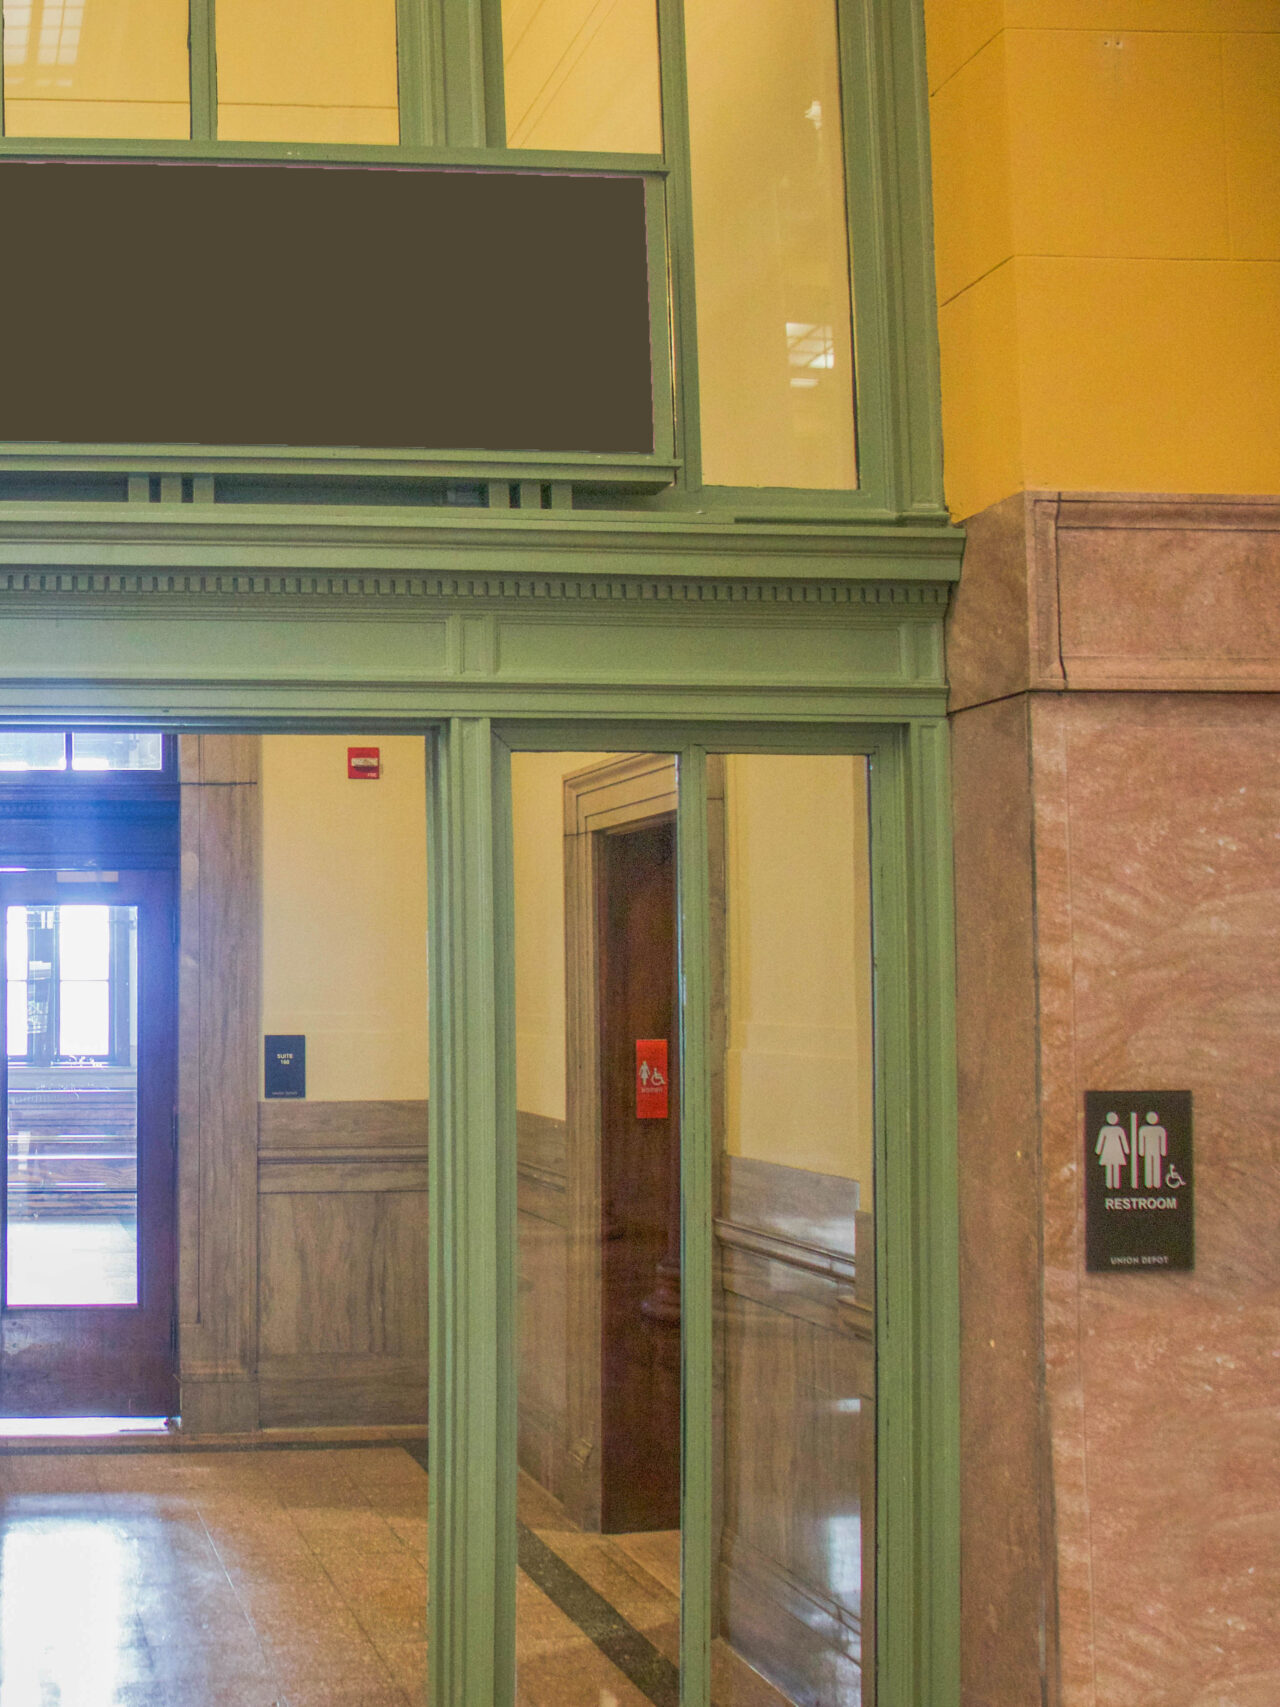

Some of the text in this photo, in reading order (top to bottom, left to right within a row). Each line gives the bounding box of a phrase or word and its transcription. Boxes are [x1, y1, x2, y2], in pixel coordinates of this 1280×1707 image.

[1105, 1197, 1178, 1210] RESTROOM
[1110, 1256, 1169, 1265] UNION DEPOT
